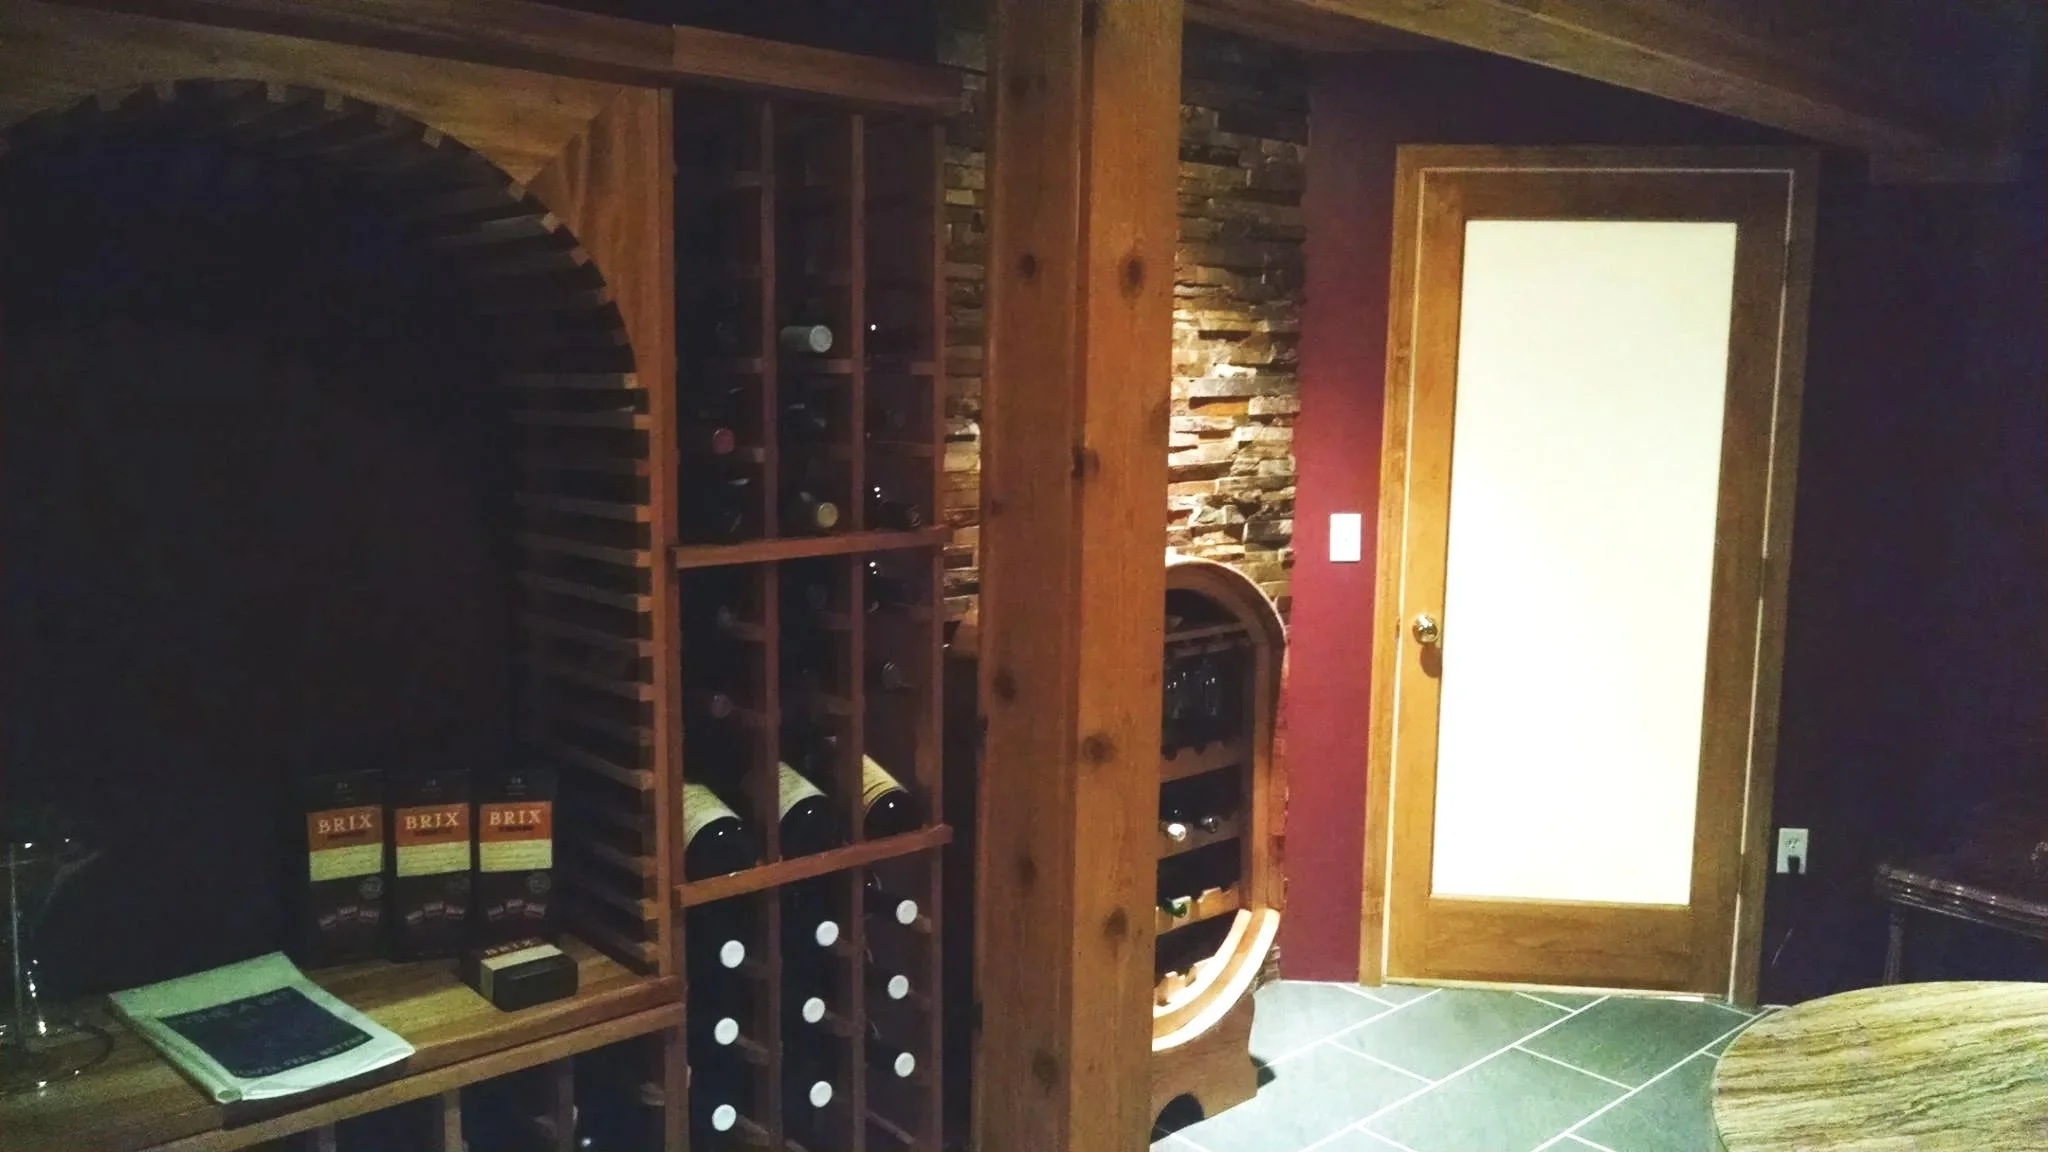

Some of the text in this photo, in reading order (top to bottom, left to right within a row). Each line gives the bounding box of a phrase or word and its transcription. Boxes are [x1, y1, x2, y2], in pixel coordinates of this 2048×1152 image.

[318, 813, 374, 835] BRIX
[405, 811, 459, 830] BRIX
[488, 808, 542, 826] BRIX
